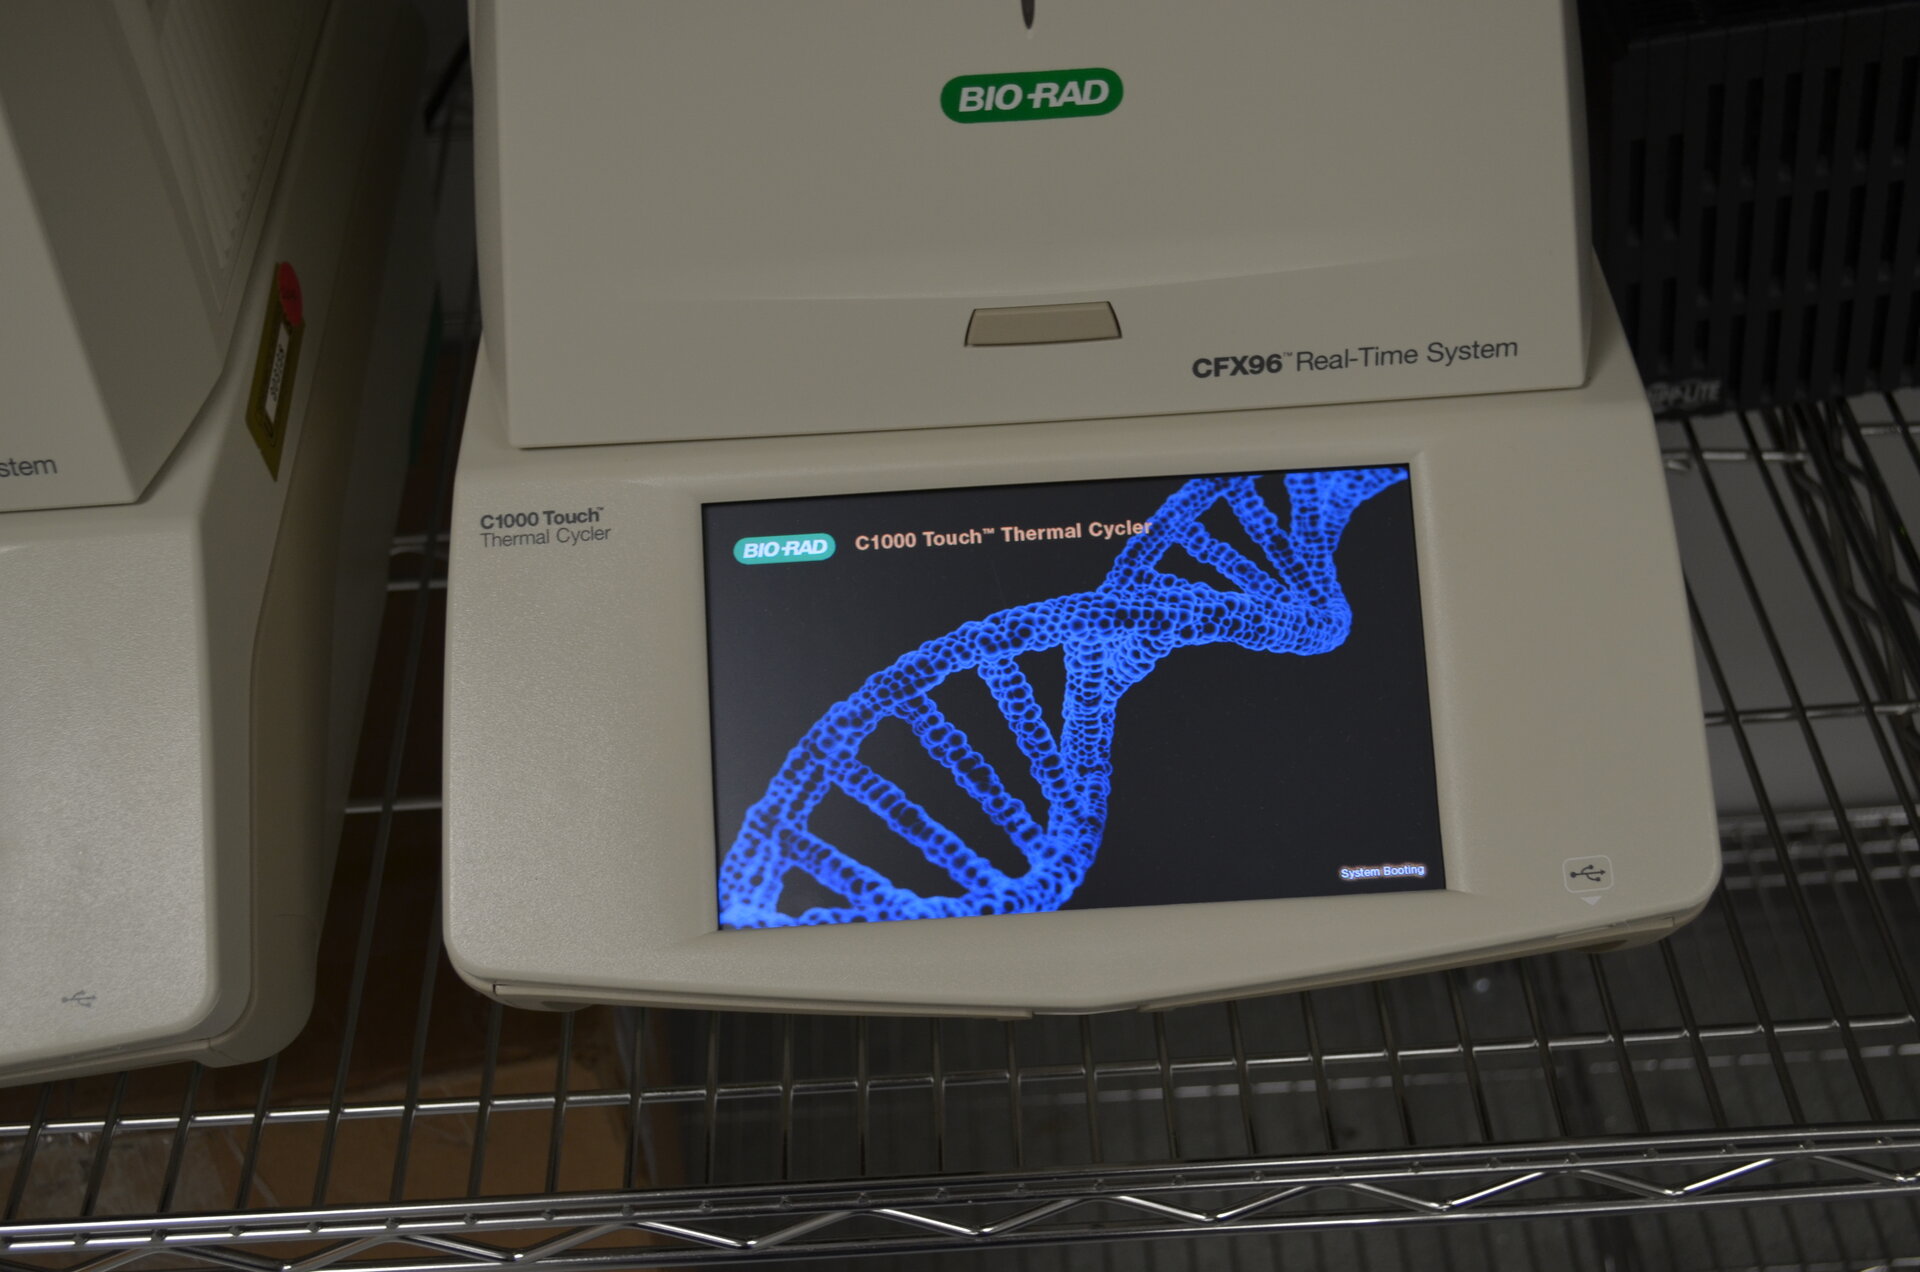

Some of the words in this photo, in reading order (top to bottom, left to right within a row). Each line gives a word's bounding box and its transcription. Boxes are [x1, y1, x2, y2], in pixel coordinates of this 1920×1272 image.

[958, 79, 1110, 113] BIO-RAD
[1296, 346, 1419, 373] Real-Time
[1426, 340, 1518, 367] System
[480, 514, 539, 530] C1000
[480, 528, 550, 548] Thermal
[556, 525, 612, 546] Cycler
[854, 532, 917, 551] C1000
[1000, 522, 1082, 543] Thermal
[1088, 519, 1153, 540] Cycler
[742, 538, 829, 559] BIO-RAD
[1340, 867, 1381, 880] System
[1383, 864, 1426, 877] Booting
